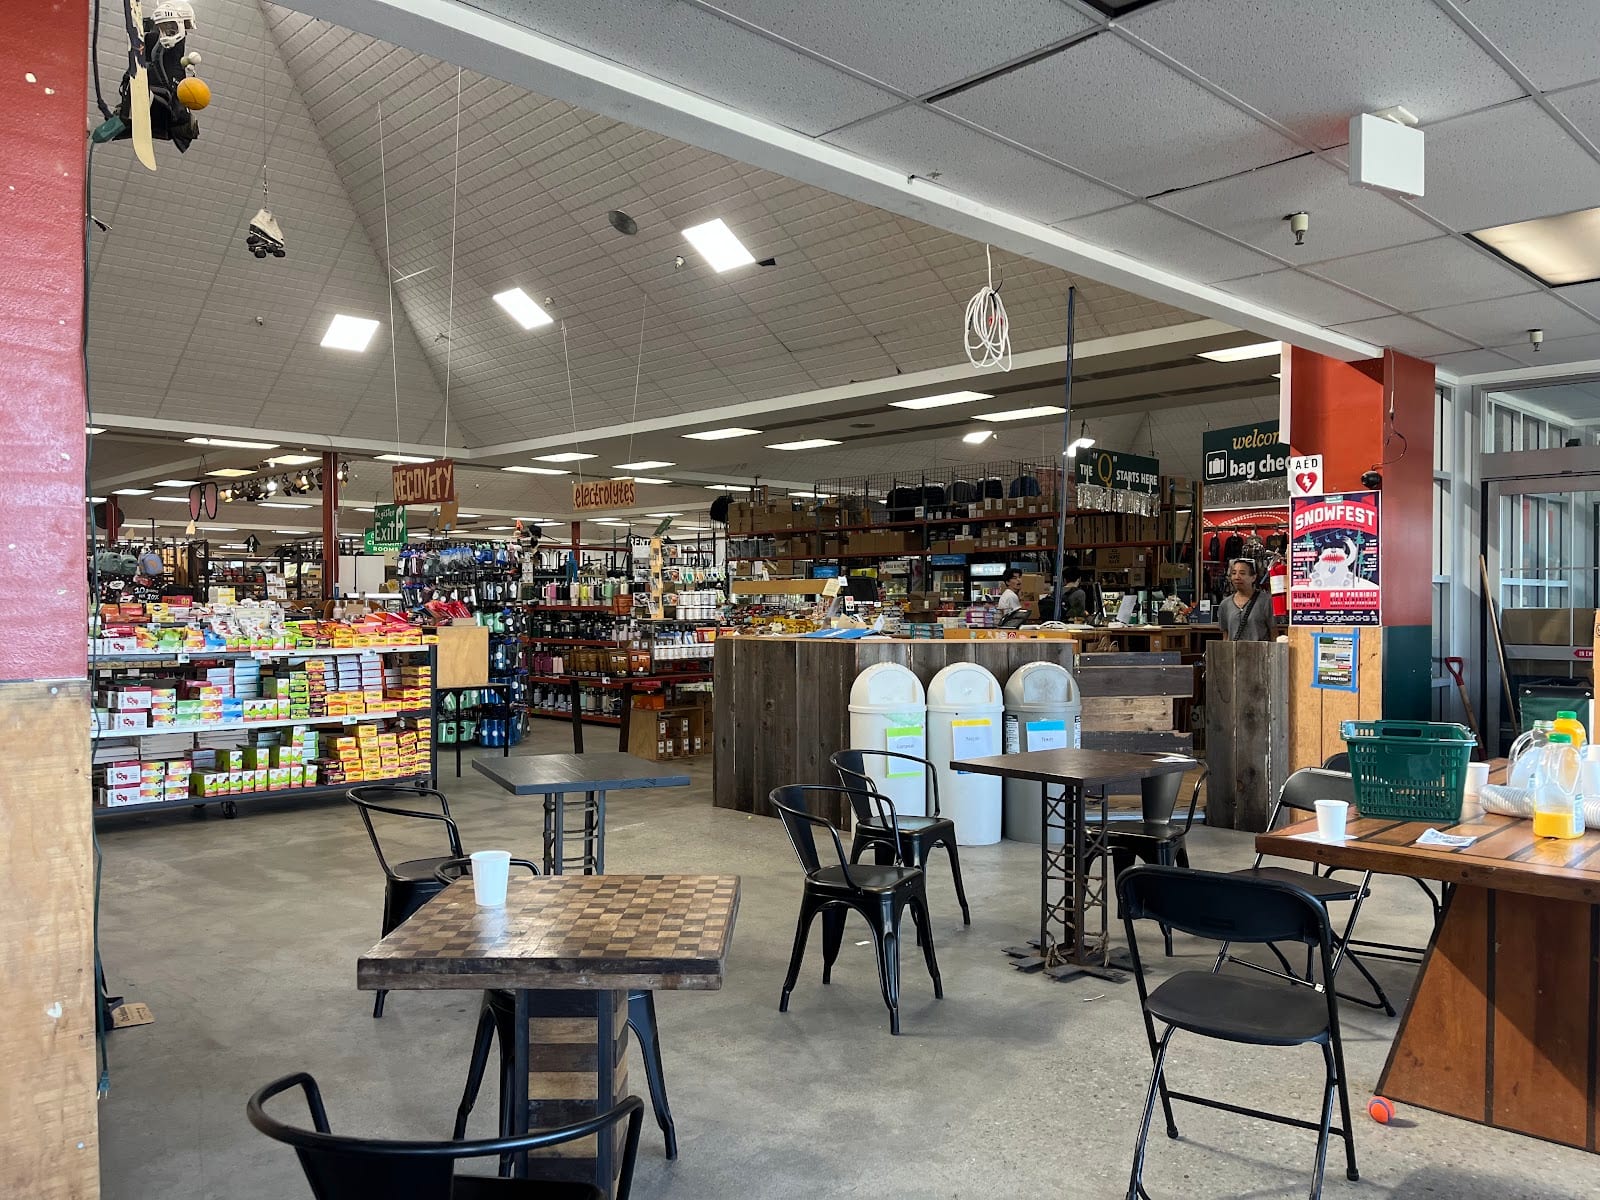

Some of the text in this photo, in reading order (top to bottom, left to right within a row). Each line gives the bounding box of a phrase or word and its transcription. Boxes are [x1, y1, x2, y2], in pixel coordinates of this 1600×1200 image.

[1232, 428, 1280, 450] welco
[1080, 463, 1094, 477] THE
[1116, 469, 1140, 483] STARTS
[1140, 472, 1158, 486] HERE
[1229, 453, 1292, 479] bag chec
[1295, 458, 1318, 470] AED
[575, 482, 635, 507] electrolytes
[1295, 505, 1375, 531] SNOWFEST
[374, 520, 396, 542] Exit
